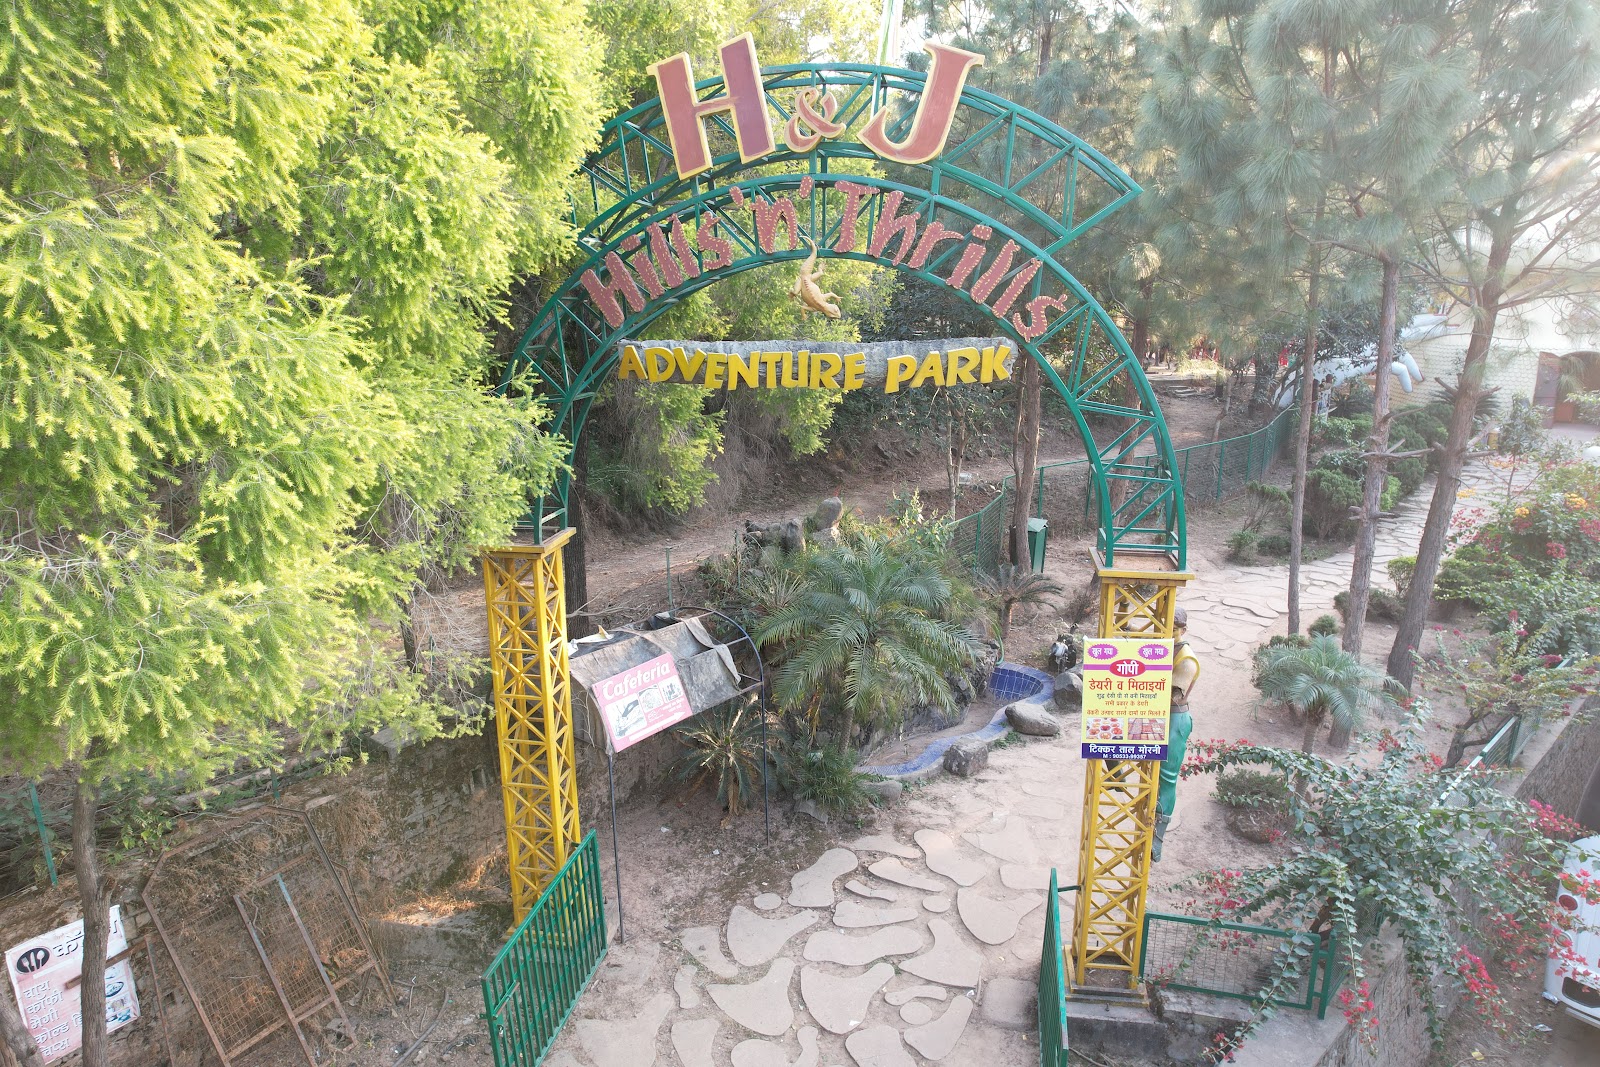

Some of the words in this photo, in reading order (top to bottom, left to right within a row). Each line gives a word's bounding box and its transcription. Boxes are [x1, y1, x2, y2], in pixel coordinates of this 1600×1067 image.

[646, 32, 775, 181] H
[784, 87, 846, 153] &
[857, 40, 984, 165] J
[834, 180, 1068, 343] Thrills
[617, 344, 866, 391] ADVENTURE
[884, 344, 1012, 394] PARK
[602, 662, 671, 700] Cafeteria
[1116, 660, 1140, 675] गोपी
[1088, 677, 1113, 691] डेयरी
[1116, 680, 1124, 691] व
[1128, 677, 1167, 692] मिठाइयाँ
[1089, 744, 1116, 754] टिक्कर
[1118, 745, 1136, 754] ताल
[1137, 744, 1162, 755] मोरनी
[23, 980, 51, 998] चाय
